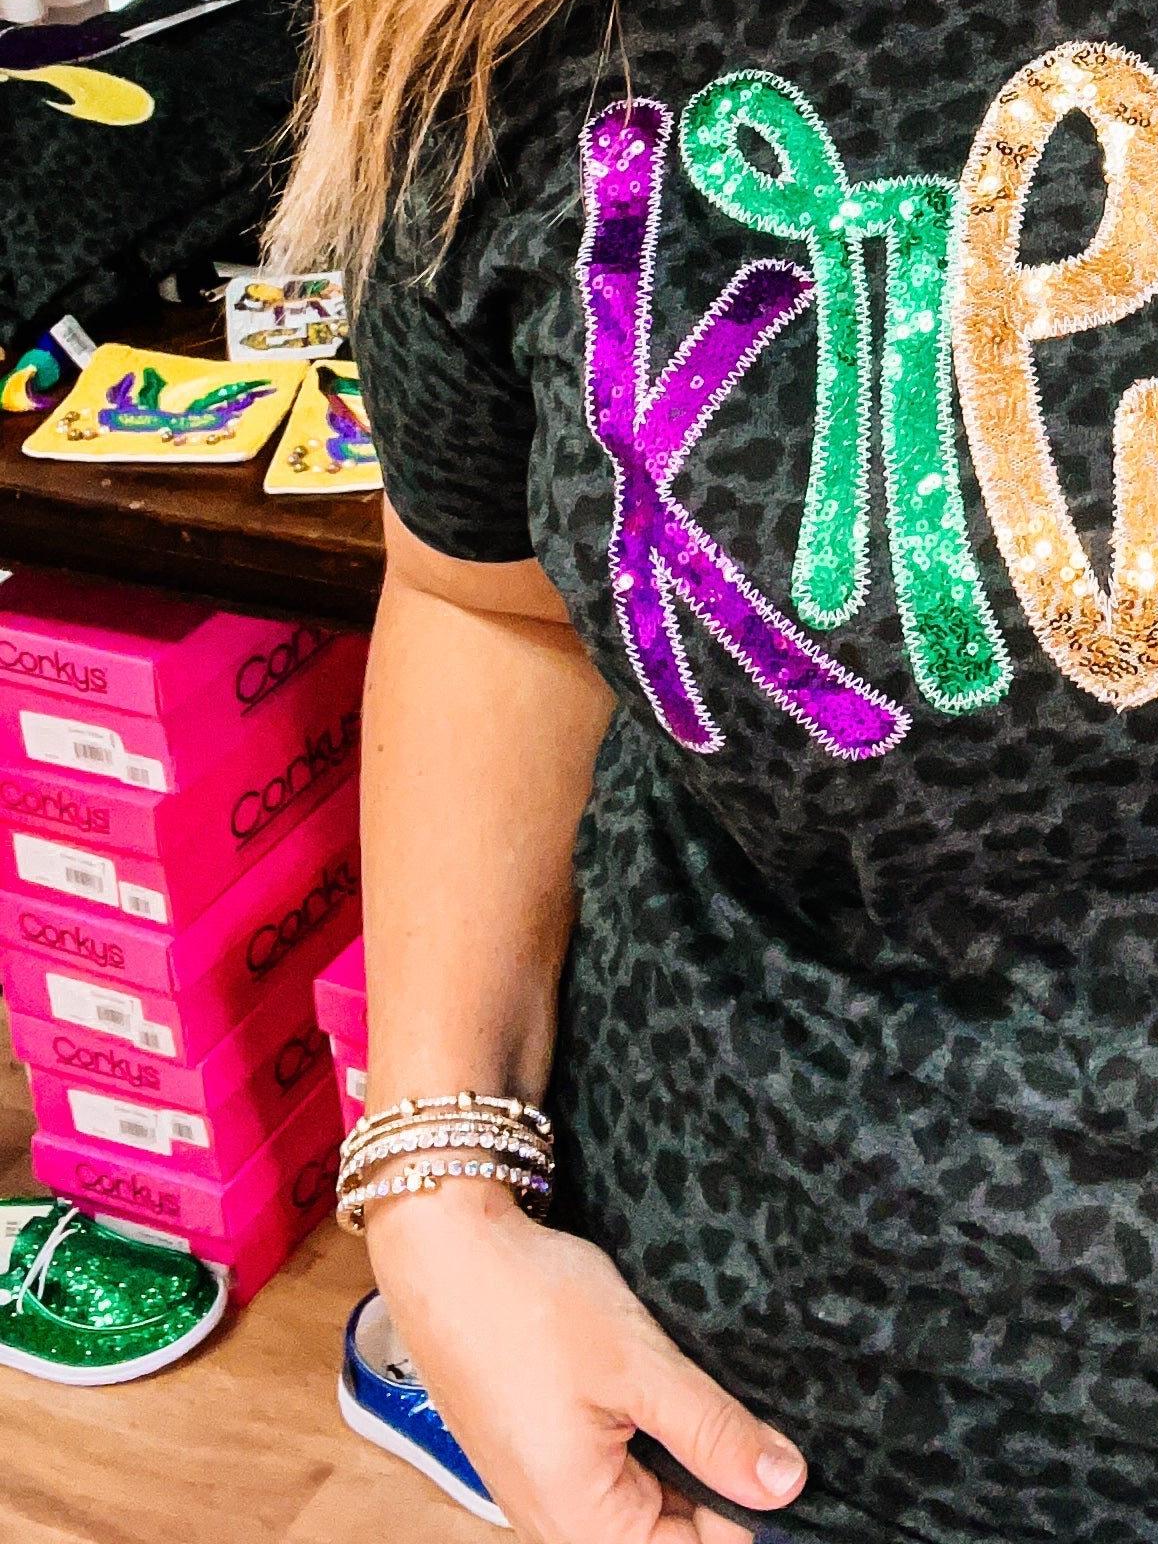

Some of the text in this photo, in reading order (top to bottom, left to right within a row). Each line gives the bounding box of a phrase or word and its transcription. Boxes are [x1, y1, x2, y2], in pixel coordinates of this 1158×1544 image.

[0, 640, 108, 695] Corkys
[1, 781, 111, 835] Corkys
[20, 913, 125, 970] Corkys
[53, 1036, 160, 1091] Corkys
[75, 1163, 181, 1217] Corkys
